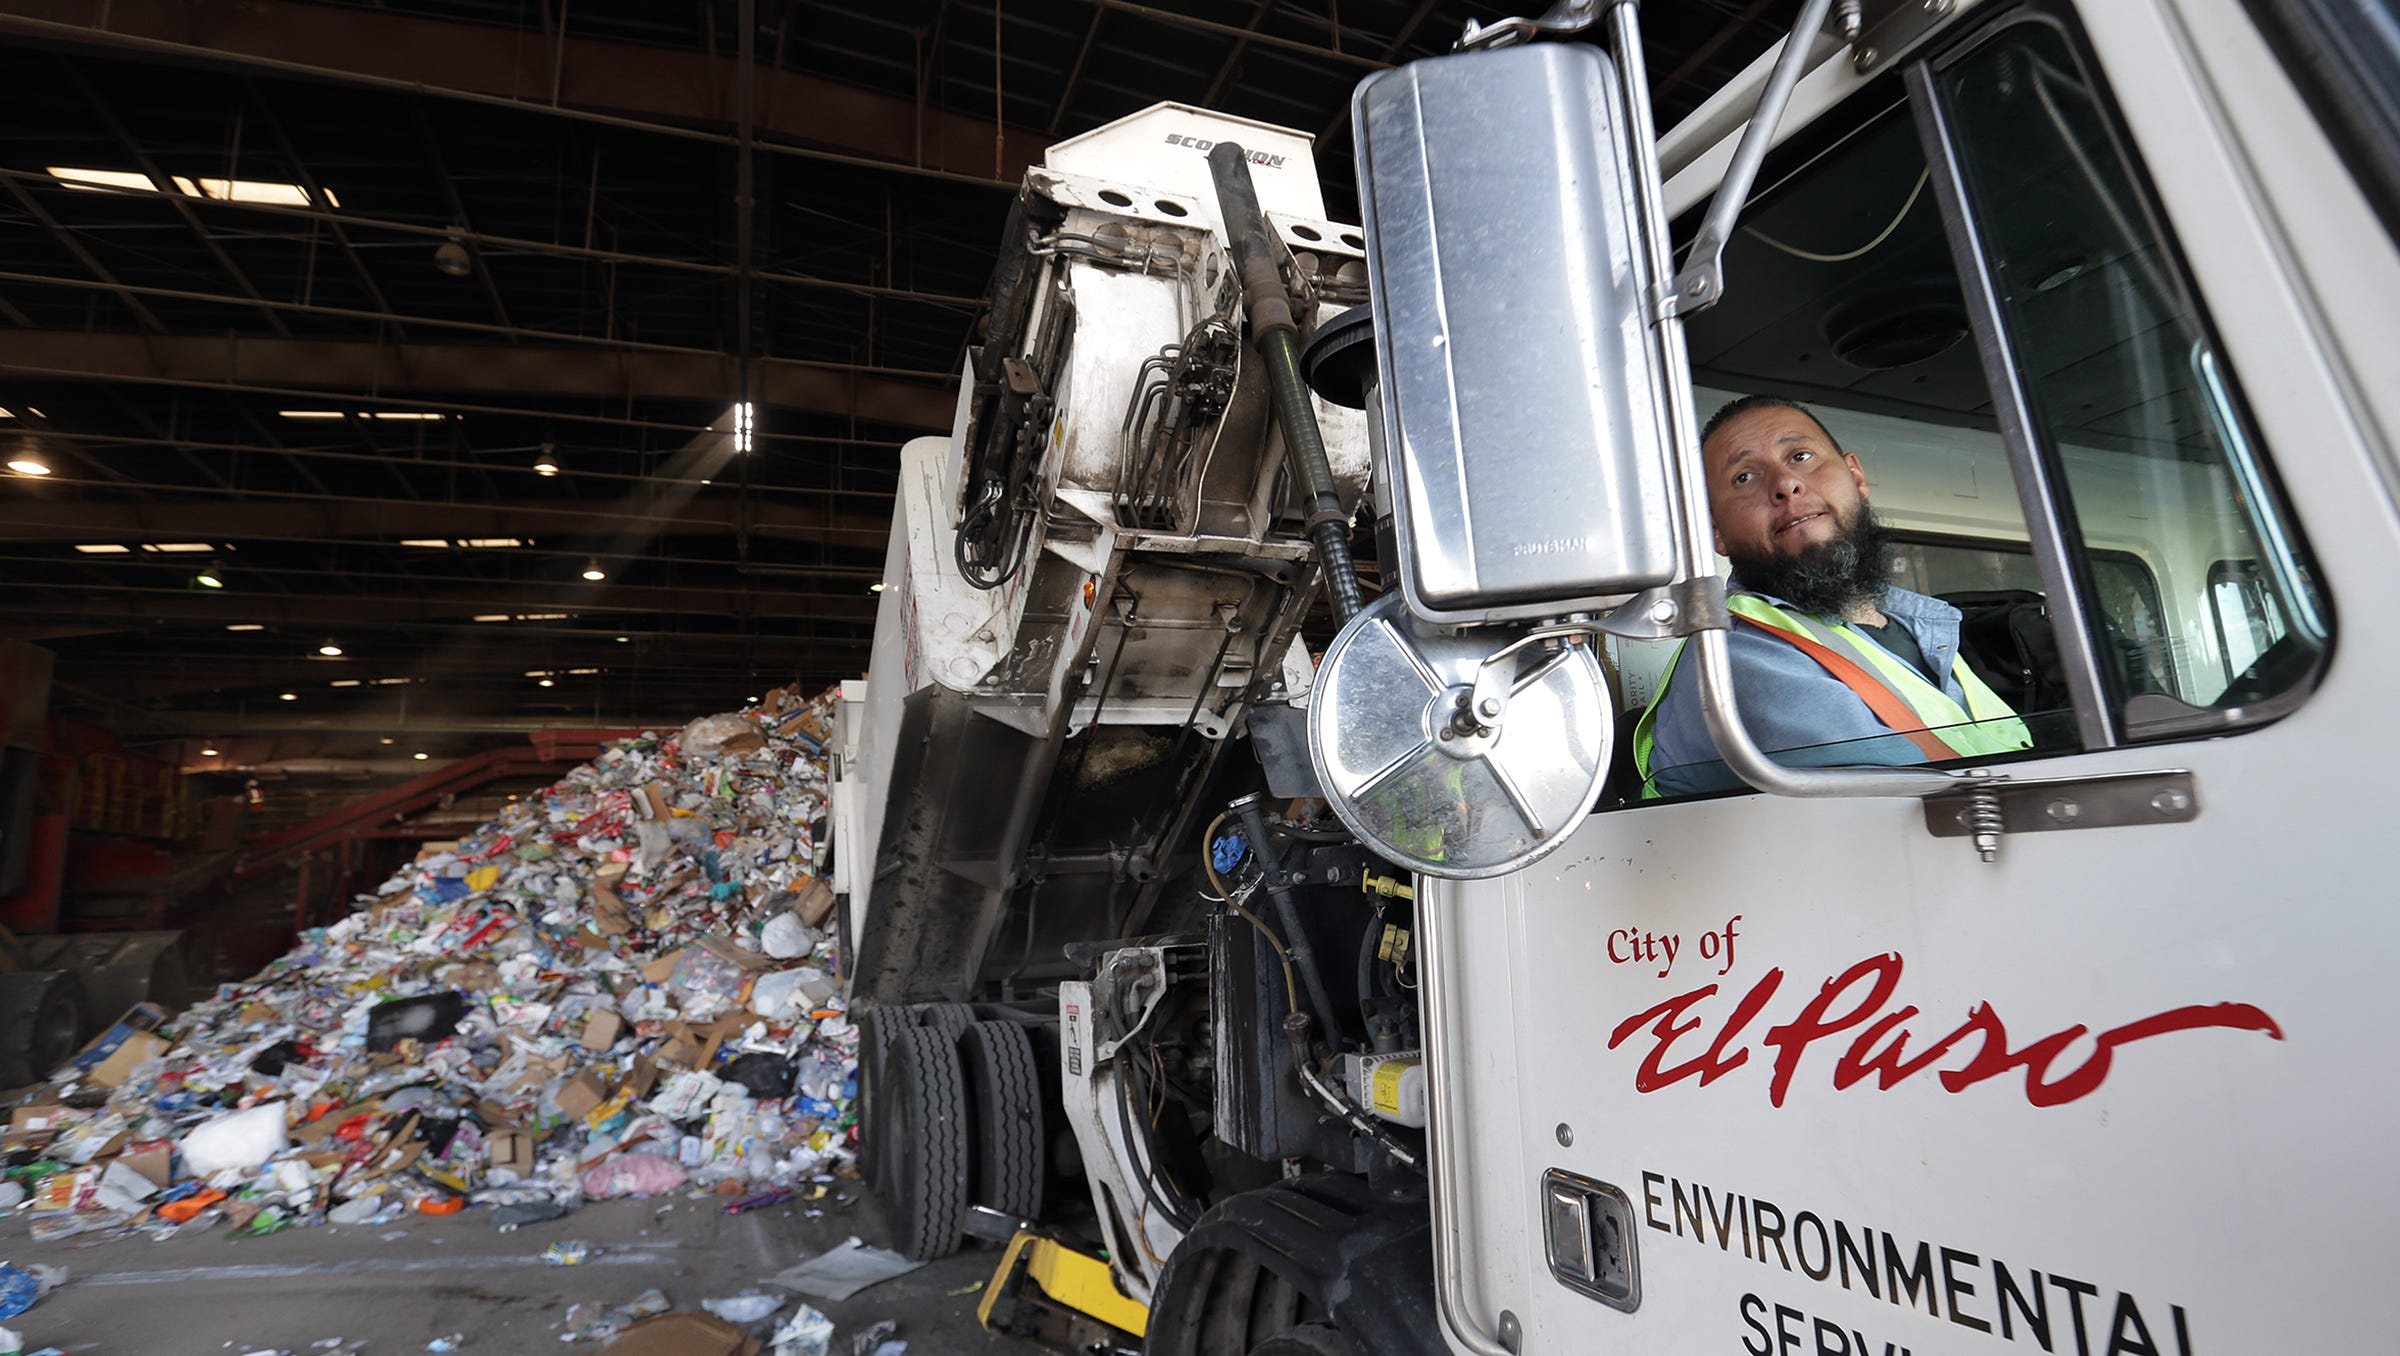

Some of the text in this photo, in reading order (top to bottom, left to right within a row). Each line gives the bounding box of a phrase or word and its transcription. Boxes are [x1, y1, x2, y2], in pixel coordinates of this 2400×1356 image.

[1165, 133, 1286, 166] SCOION
[1607, 915, 1742, 978] City of
[1608, 952, 2284, 1108] El Paso
